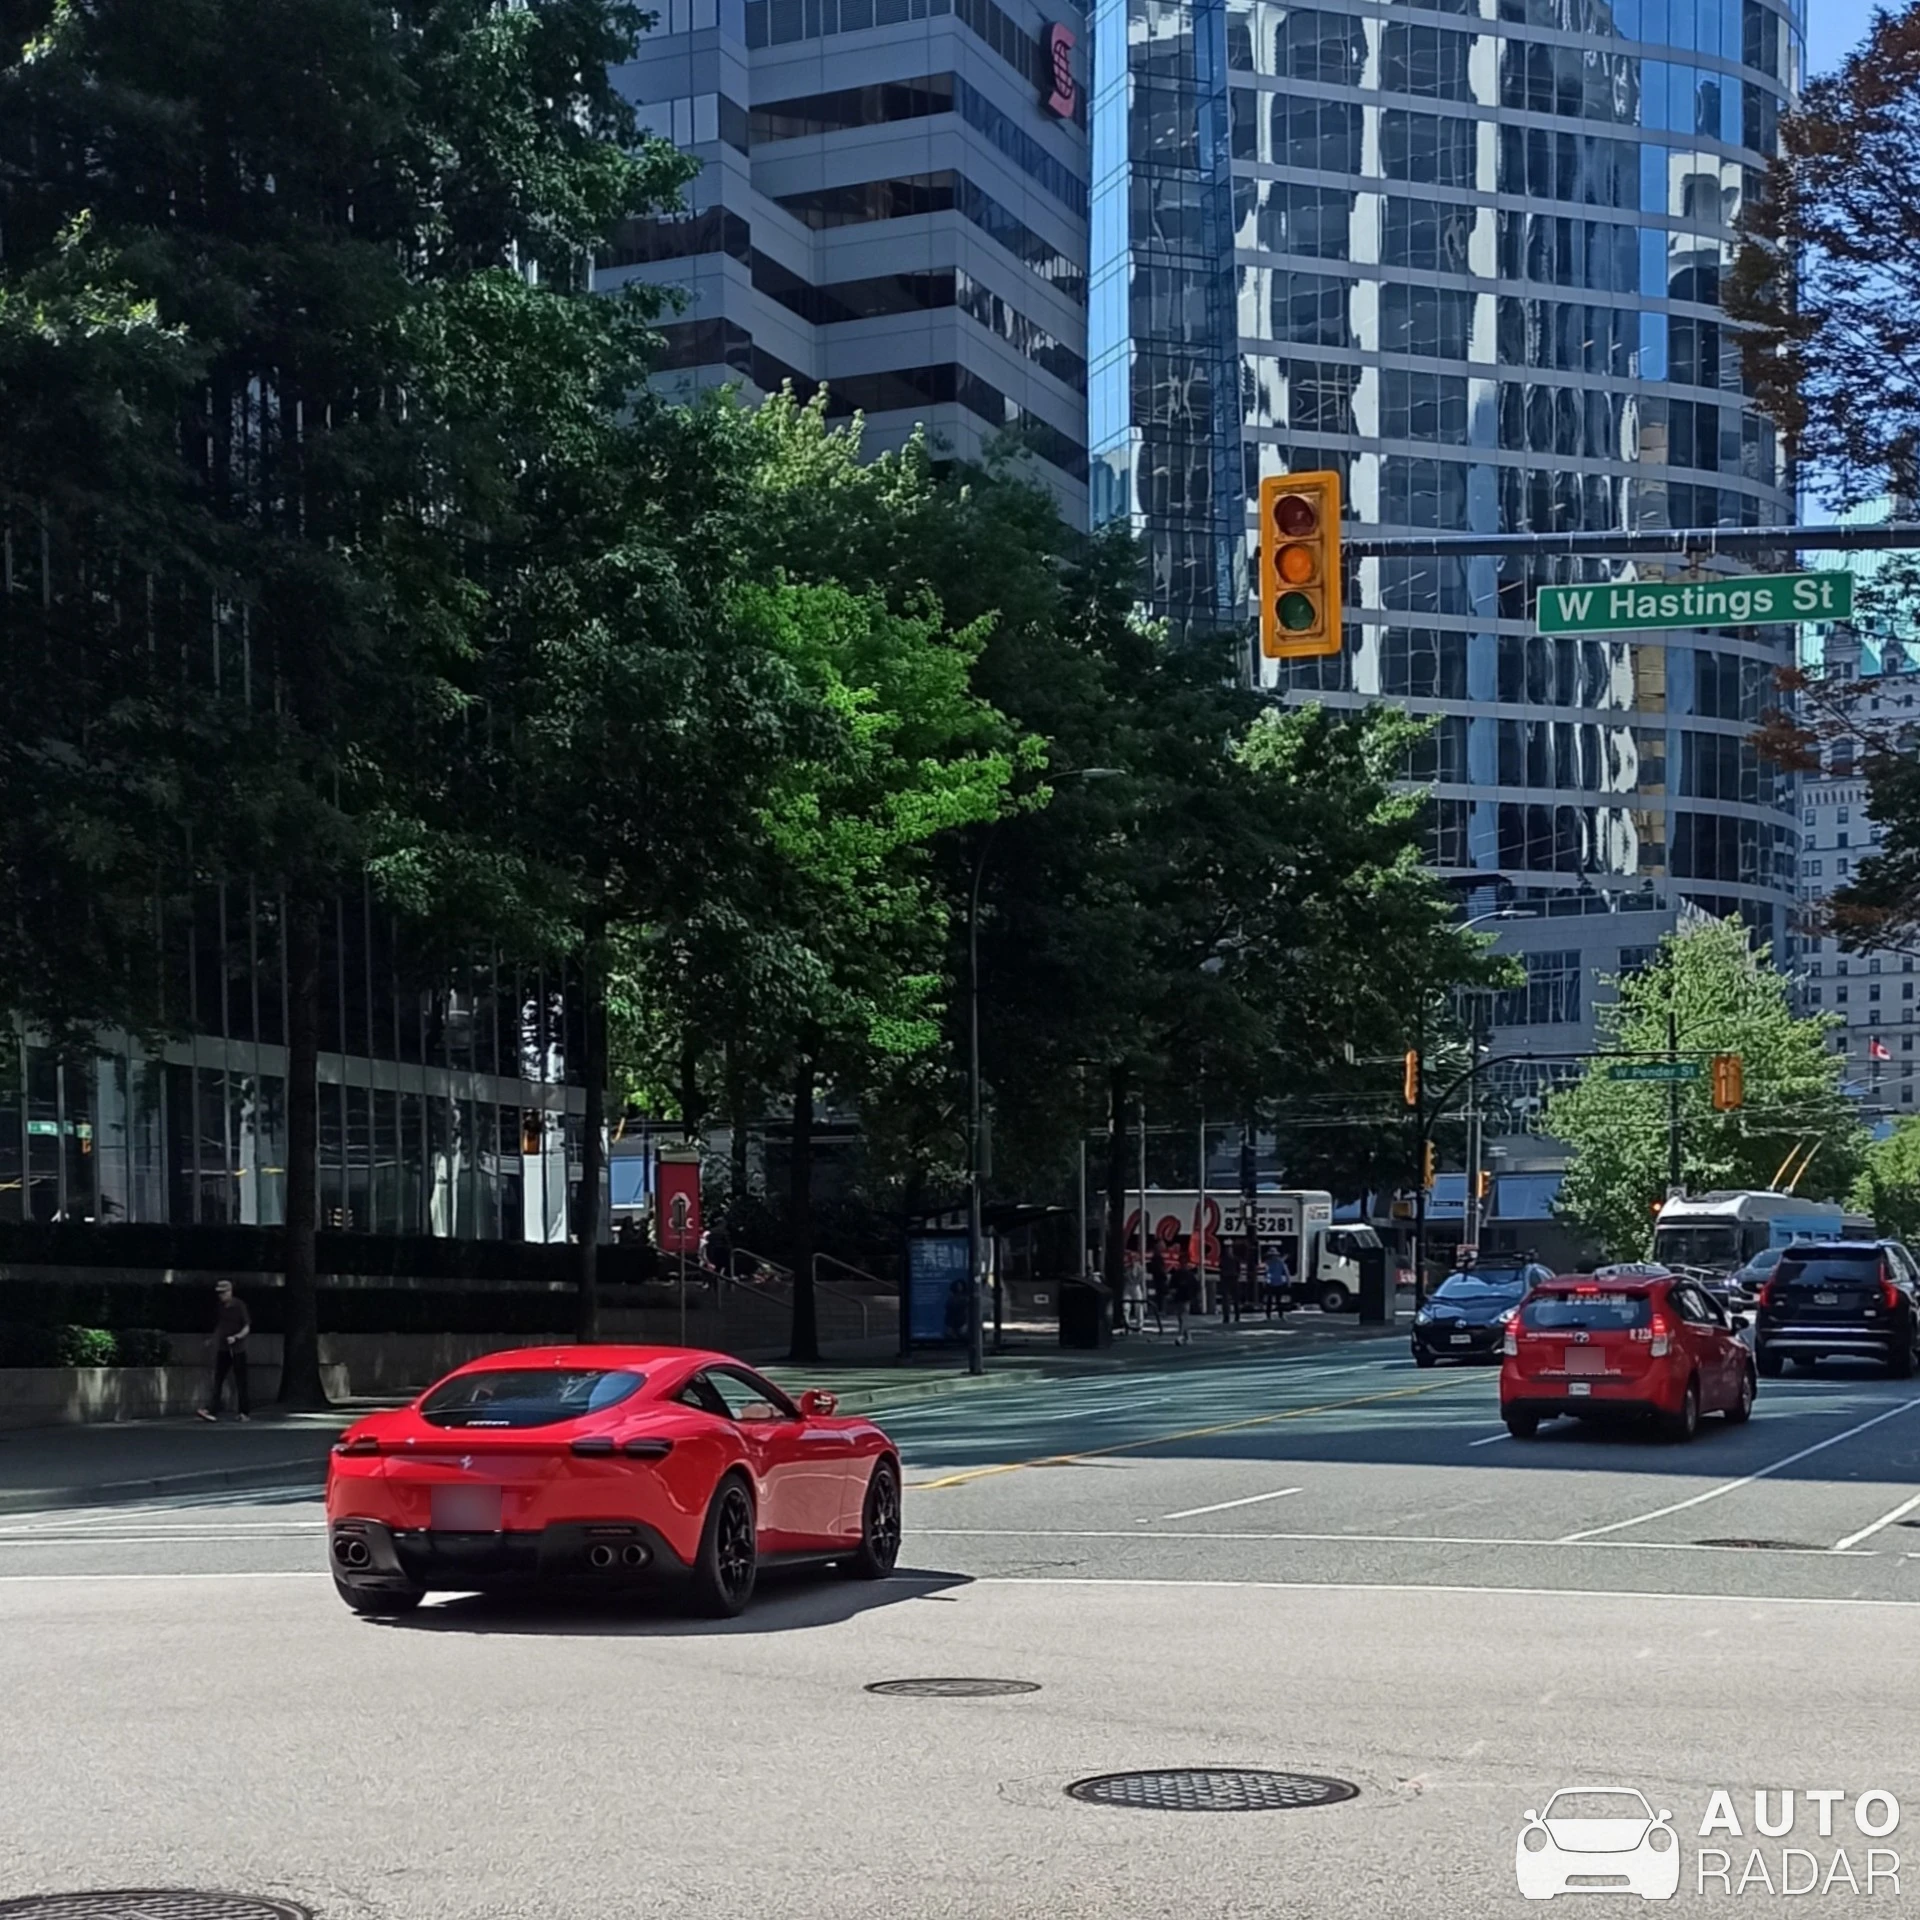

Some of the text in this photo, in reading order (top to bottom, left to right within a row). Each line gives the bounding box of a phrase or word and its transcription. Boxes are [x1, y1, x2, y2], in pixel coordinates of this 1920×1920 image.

[1558, 579, 1834, 621] W Hastings St
[1615, 1064, 1695, 1078] W Pender St
[1619, 1265, 1647, 1276] TAXI
